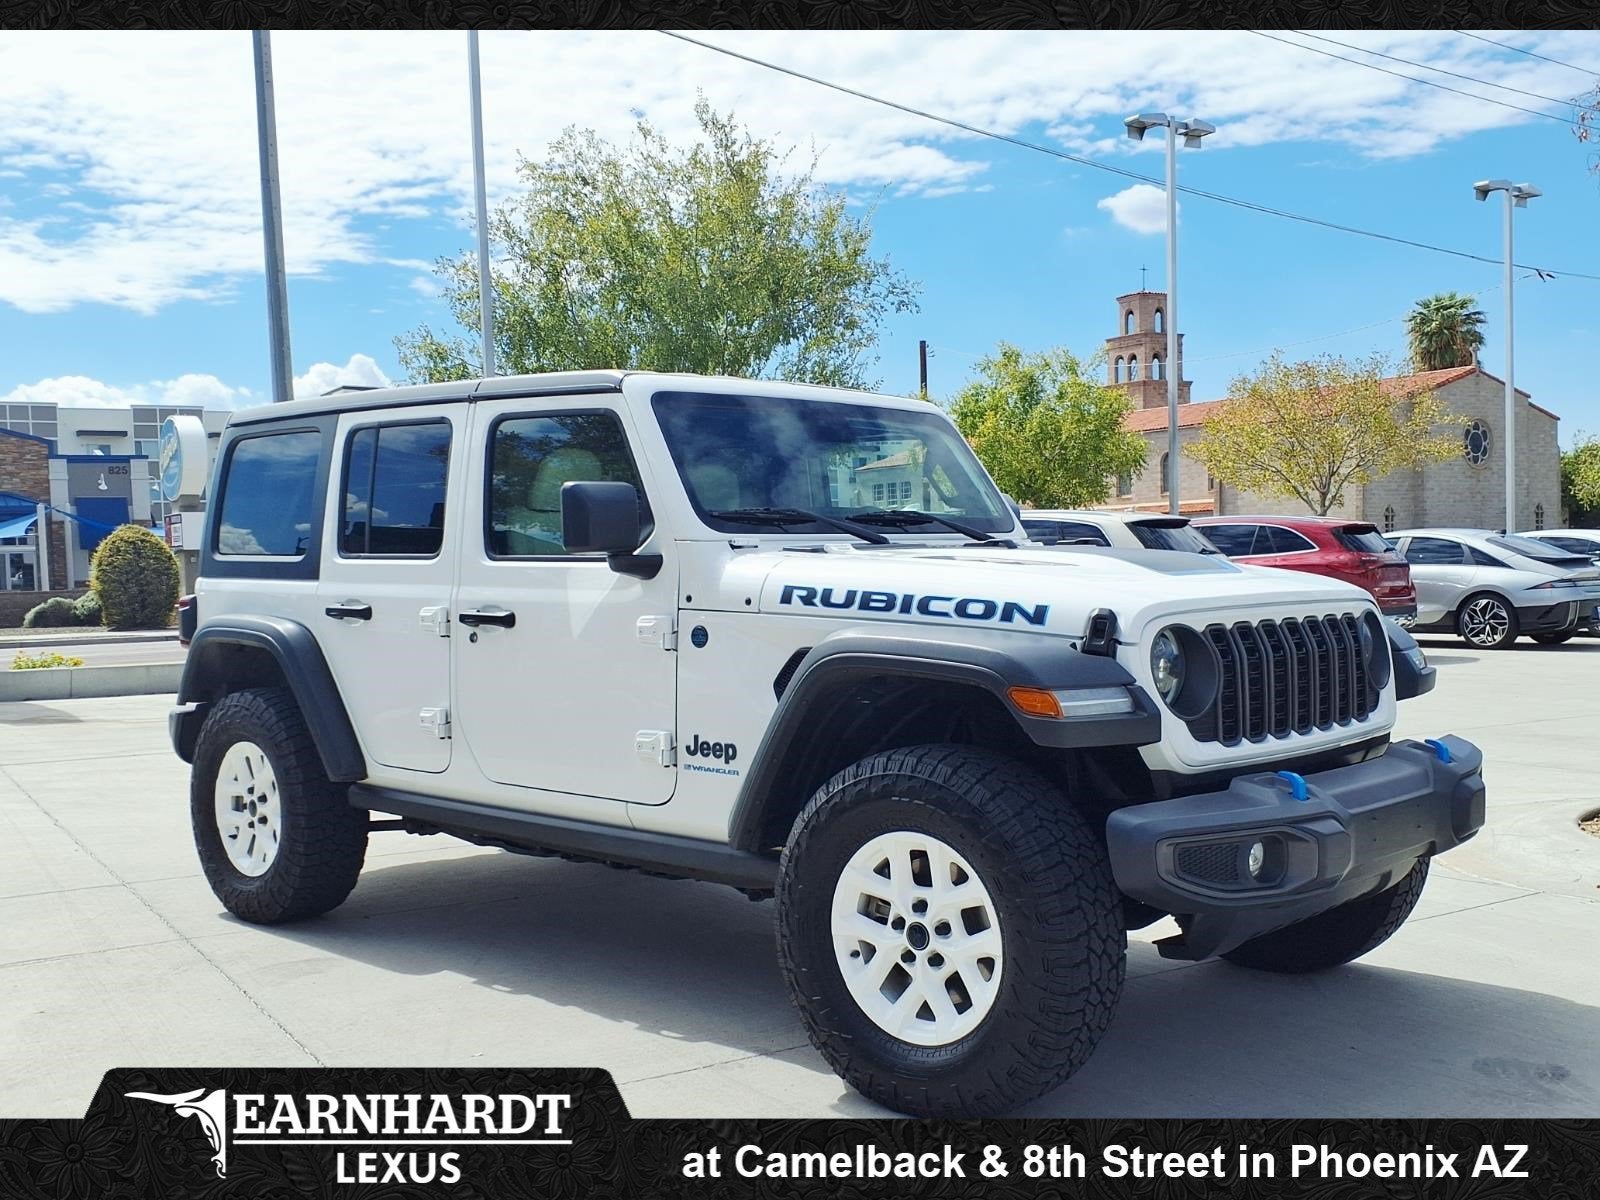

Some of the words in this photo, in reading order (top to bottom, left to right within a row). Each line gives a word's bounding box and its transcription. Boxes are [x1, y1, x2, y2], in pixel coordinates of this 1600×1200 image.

[108, 466, 128, 475] 825
[779, 585, 1050, 626] RUBICON
[685, 734, 738, 765] Jeep
[692, 764, 739, 776] WRANGLER
